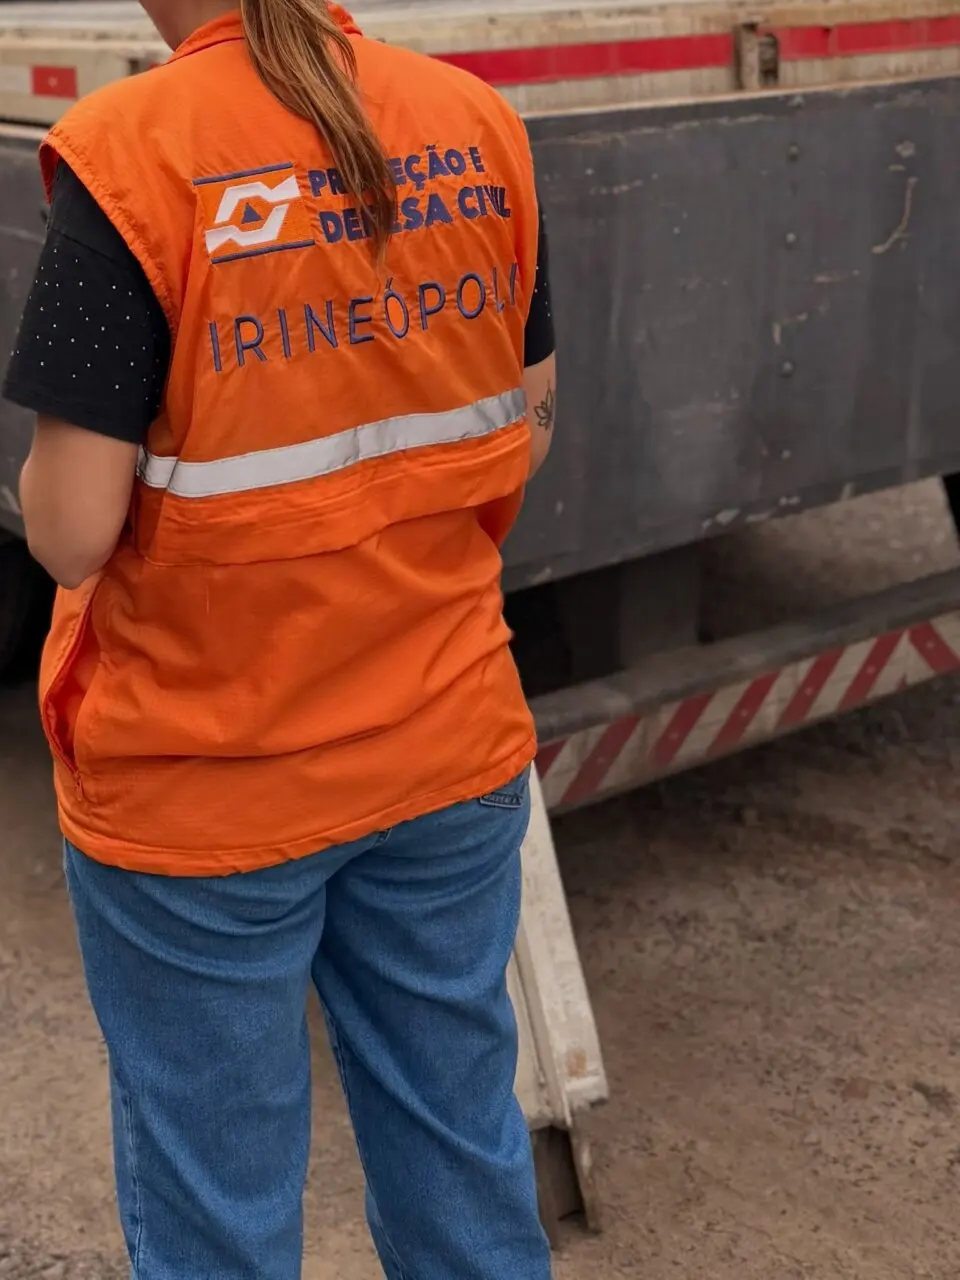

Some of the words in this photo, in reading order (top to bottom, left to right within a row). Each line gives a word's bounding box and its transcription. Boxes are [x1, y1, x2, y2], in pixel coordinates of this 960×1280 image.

[307, 144, 467, 197] PREÇÃO
[467, 146, 485, 173] E
[319, 192, 454, 244] DESA
[208, 262, 518, 372] IRINEÓPOLI
